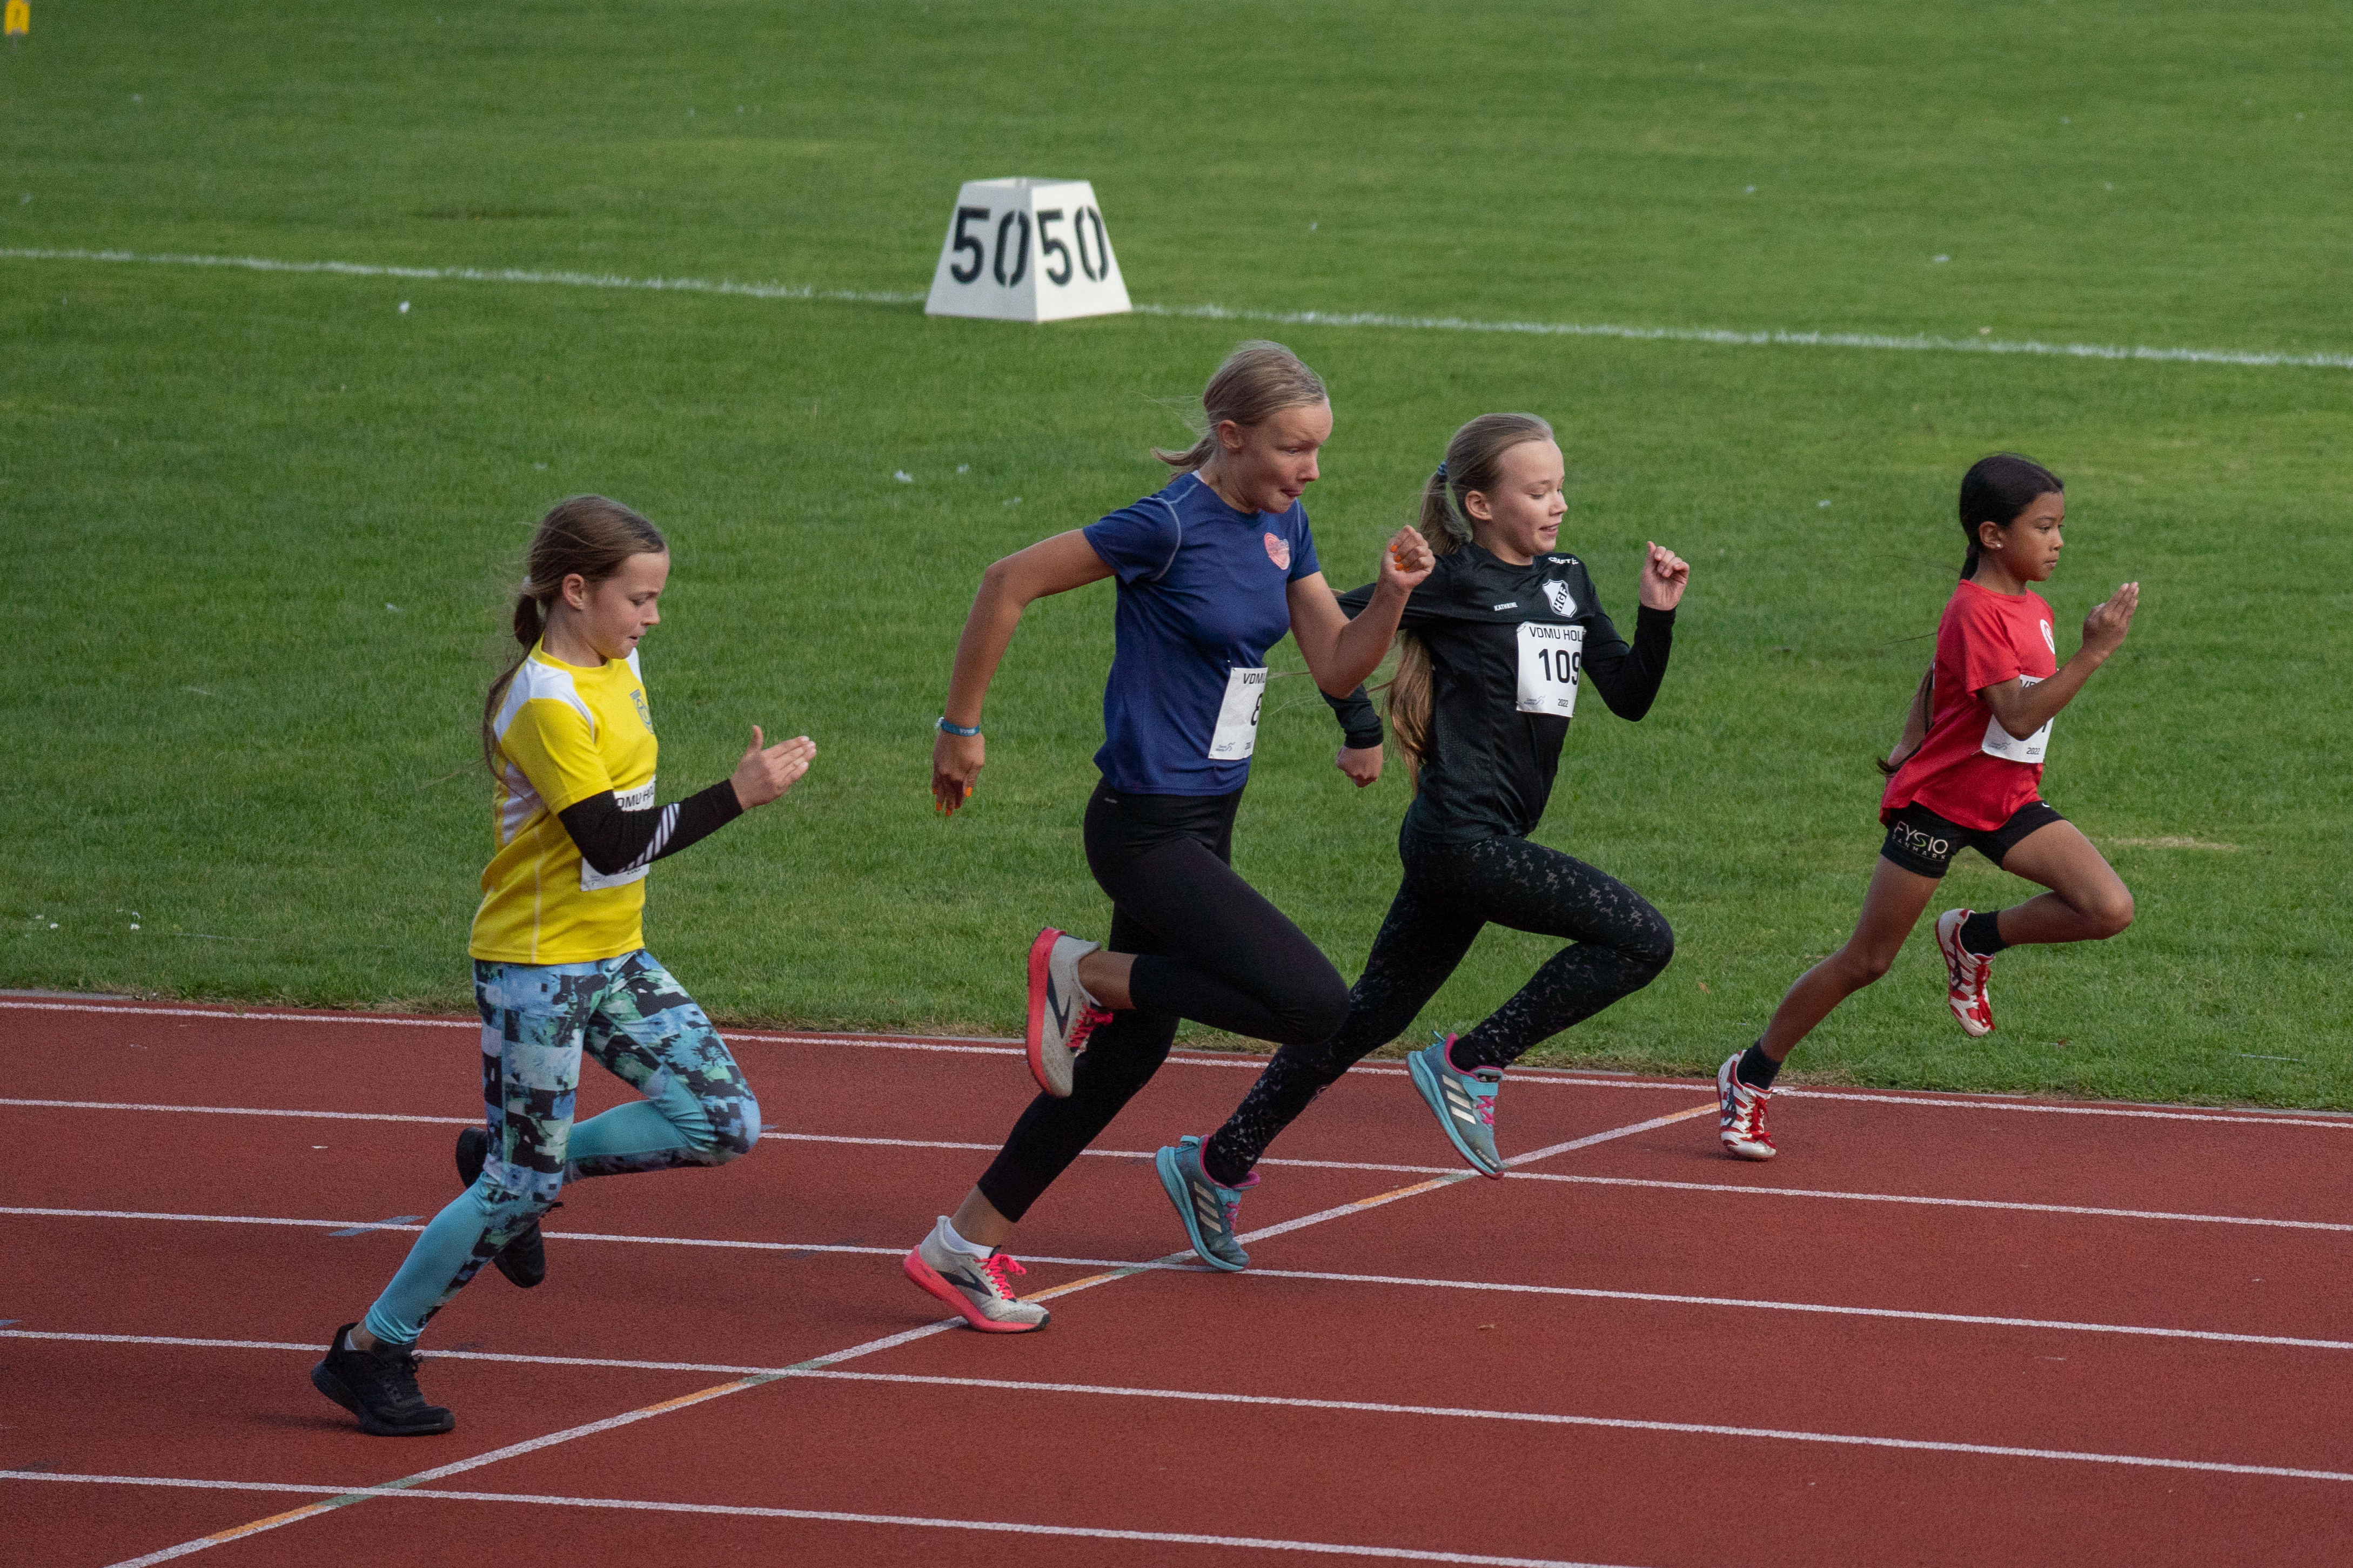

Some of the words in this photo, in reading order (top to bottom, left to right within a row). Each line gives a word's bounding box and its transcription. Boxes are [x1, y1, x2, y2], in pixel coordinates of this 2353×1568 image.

[950, 207, 1031, 288] 50
[1036, 206, 1109, 286] 50
[1553, 587, 1568, 613] HGF
[1529, 627, 1560, 640] VDMU
[616, 792, 642, 808] DMU
[1892, 834, 1946, 859] DANMARK
[1894, 821, 1948, 853] FYSIO
